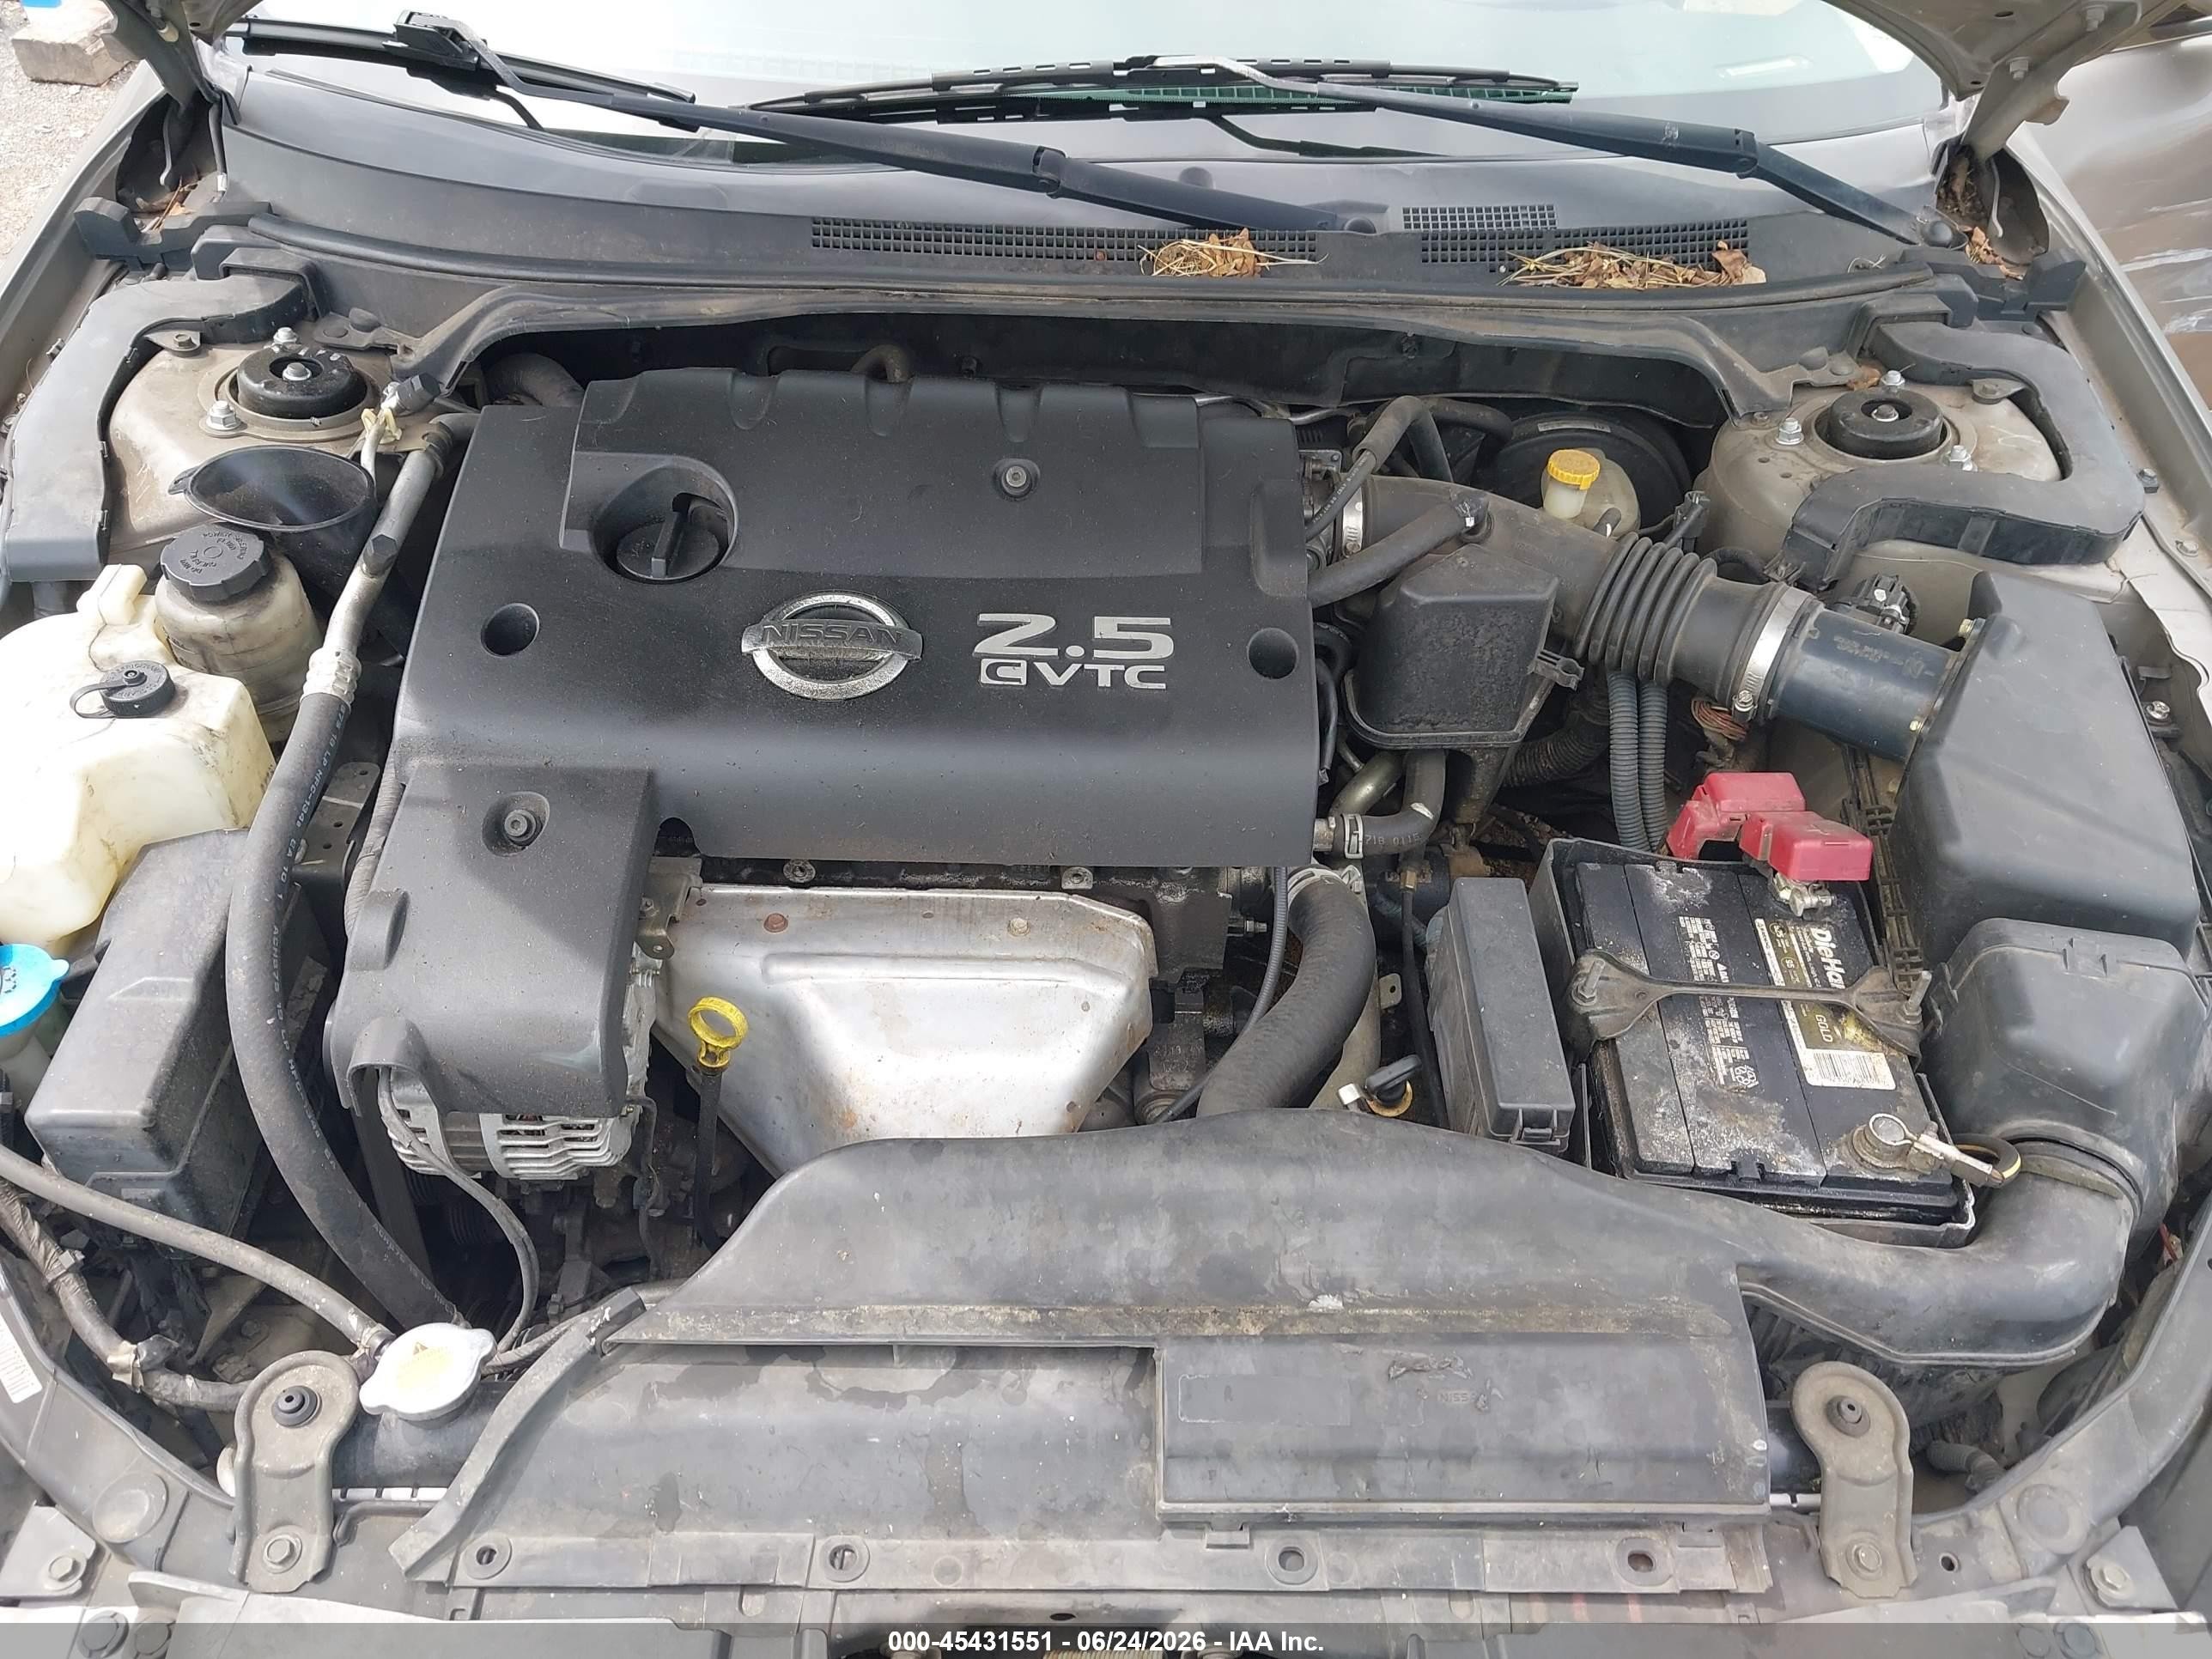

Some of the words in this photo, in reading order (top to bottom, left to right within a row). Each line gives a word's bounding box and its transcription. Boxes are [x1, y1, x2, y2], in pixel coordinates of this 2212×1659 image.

[761, 623, 905, 646] NISSAN
[974, 613, 1174, 660] 2.5
[1810, 927, 1846, 989] DieHar
[1814, 1013, 1834, 1043] GOLD
